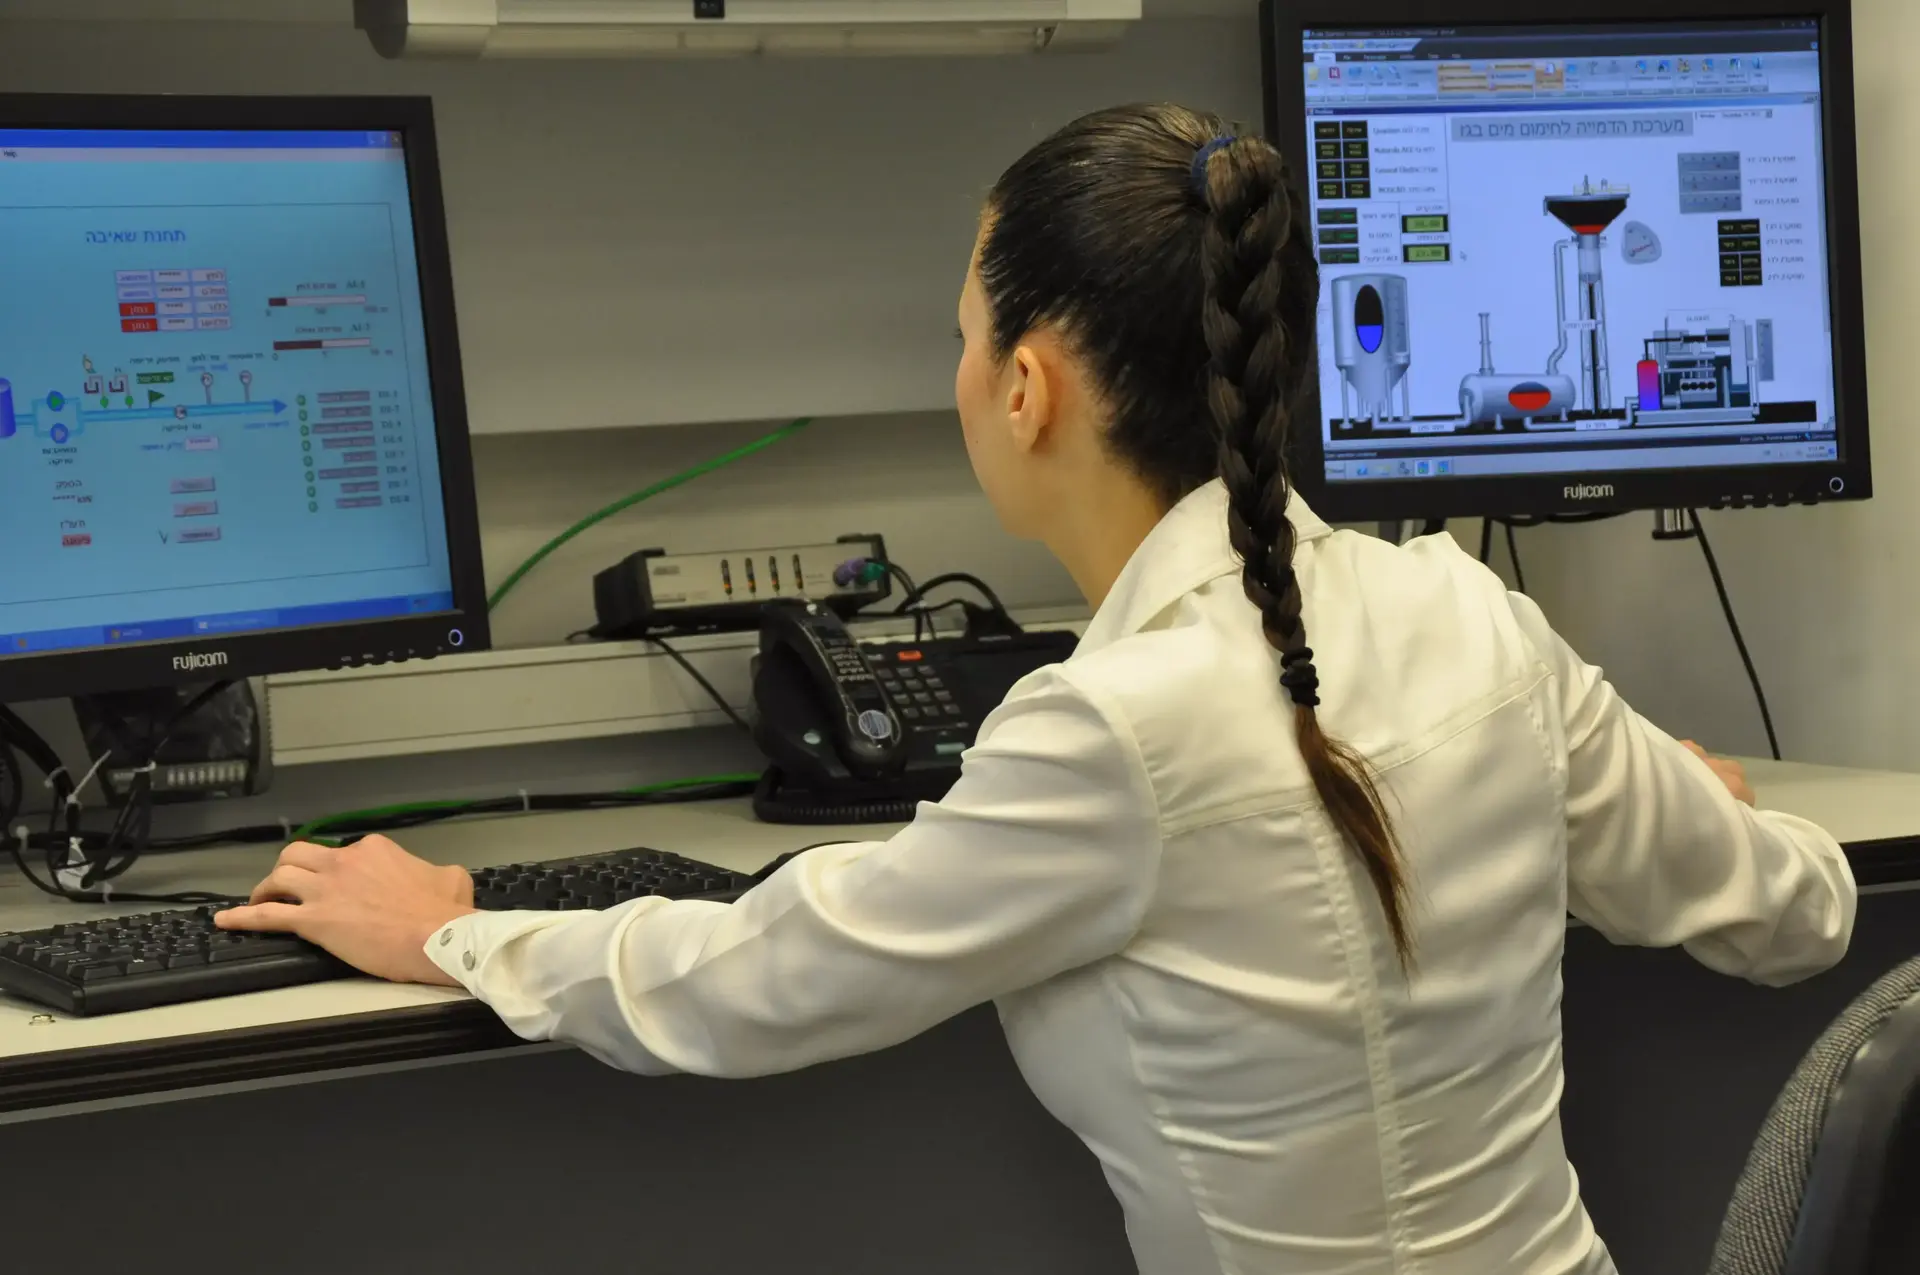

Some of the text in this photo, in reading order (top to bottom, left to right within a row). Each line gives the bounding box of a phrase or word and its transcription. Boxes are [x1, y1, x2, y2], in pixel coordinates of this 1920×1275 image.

[1488, 122, 1515, 138] מים
[1520, 119, 1571, 137] לחימום
[1576, 120, 1628, 135] הדמייה
[1632, 119, 1685, 134] מערכת
[85, 230, 186, 244] תחנת שאיבה
